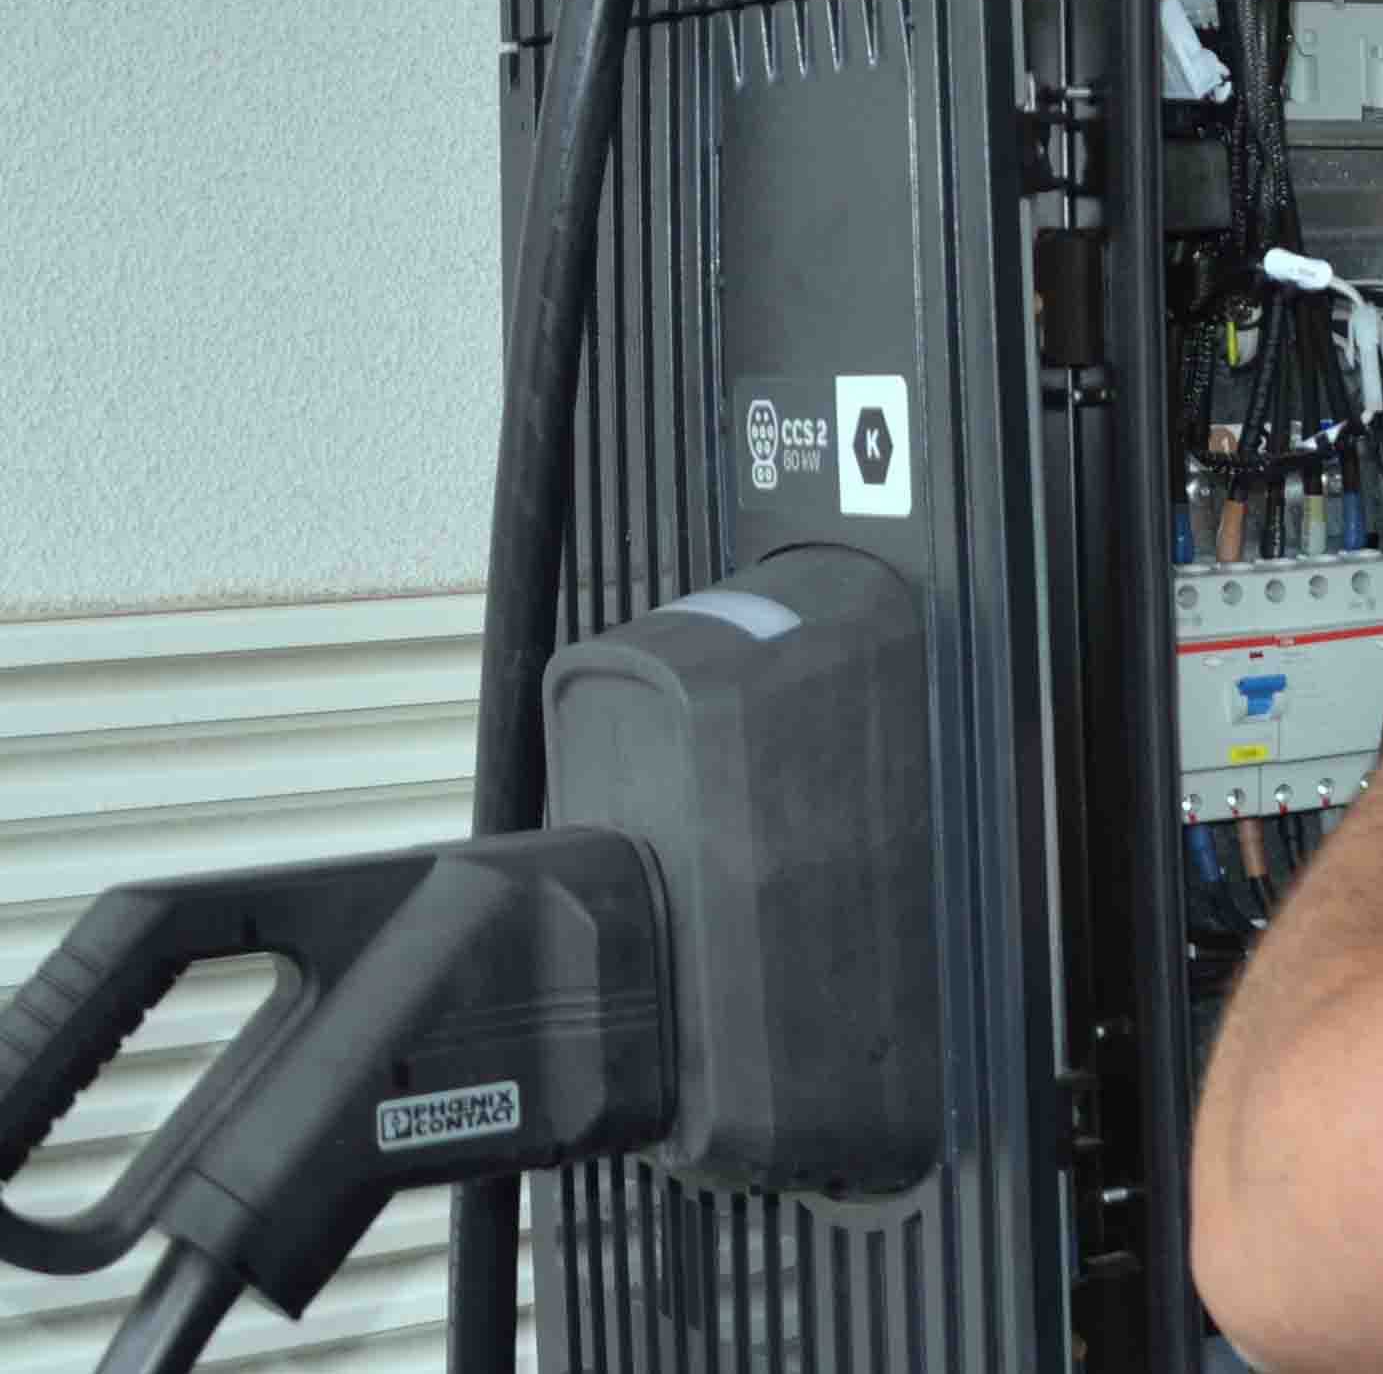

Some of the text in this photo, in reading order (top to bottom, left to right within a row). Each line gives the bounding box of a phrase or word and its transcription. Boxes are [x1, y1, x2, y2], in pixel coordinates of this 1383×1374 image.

[781, 418, 828, 447] CCS 2
[866, 428, 881, 460] K
[414, 1108, 513, 1136] CONTACT
